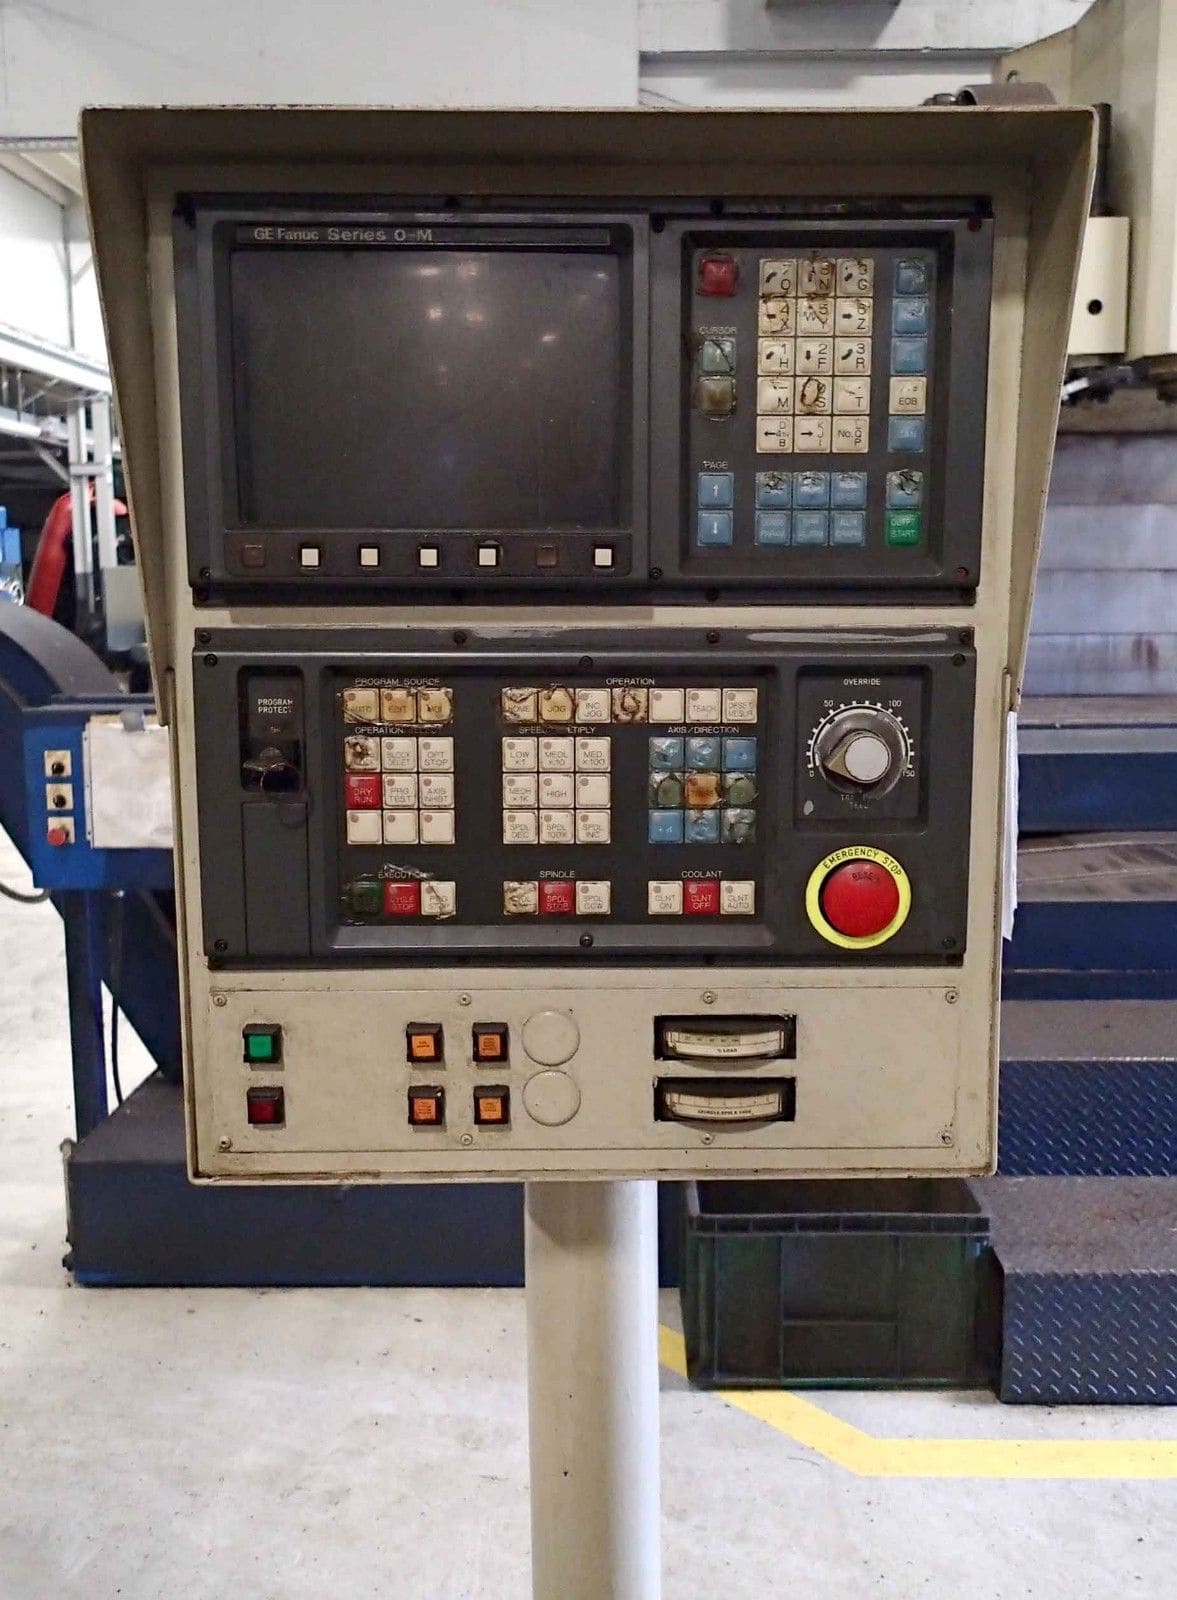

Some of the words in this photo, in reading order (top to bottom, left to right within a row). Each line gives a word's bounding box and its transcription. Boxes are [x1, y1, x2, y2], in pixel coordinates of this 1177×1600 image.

[254, 228, 274, 240] GE
[277, 228, 319, 240] Fanuc
[327, 228, 387, 241] Series
[819, 279, 829, 290] N
[857, 279, 868, 290] G
[780, 304, 790, 314] 4
[856, 317, 866, 329] Z
[818, 343, 828, 355] 2
[855, 342, 866, 354] 3
[779, 357, 789, 368] H
[817, 357, 827, 369] F
[855, 357, 866, 369] R
[777, 397, 789, 408] M
[853, 396, 864, 407] T
[779, 438, 786, 447] B
[854, 438, 863, 447] P
[703, 461, 728, 469] PAGE
[354, 678, 400, 686] PROGRAM
[403, 678, 440, 686] SOURCE
[605, 677, 655, 686] OPERATION
[843, 678, 881, 686] OVERRIDE
[257, 698, 293, 706] PROGRAM
[547, 705, 566, 713] JOG
[354, 726, 404, 734] OPERATION
[902, 770, 915, 778] 150
[353, 787, 373, 796] DRY
[546, 790, 567, 798] HIGH
[354, 796, 373, 804] RUN
[822, 847, 879, 869] EMERGENCY
[882, 856, 902, 876] STOP
[539, 870, 576, 878] SPINDLE
[681, 870, 723, 878] COOLANT
[655, 894, 676, 902] CLNT
[691, 894, 712, 902] CLNT
[727, 894, 748, 902] CLNT
[692, 902, 711, 910] OFF
[727, 902, 750, 910] AUTO
